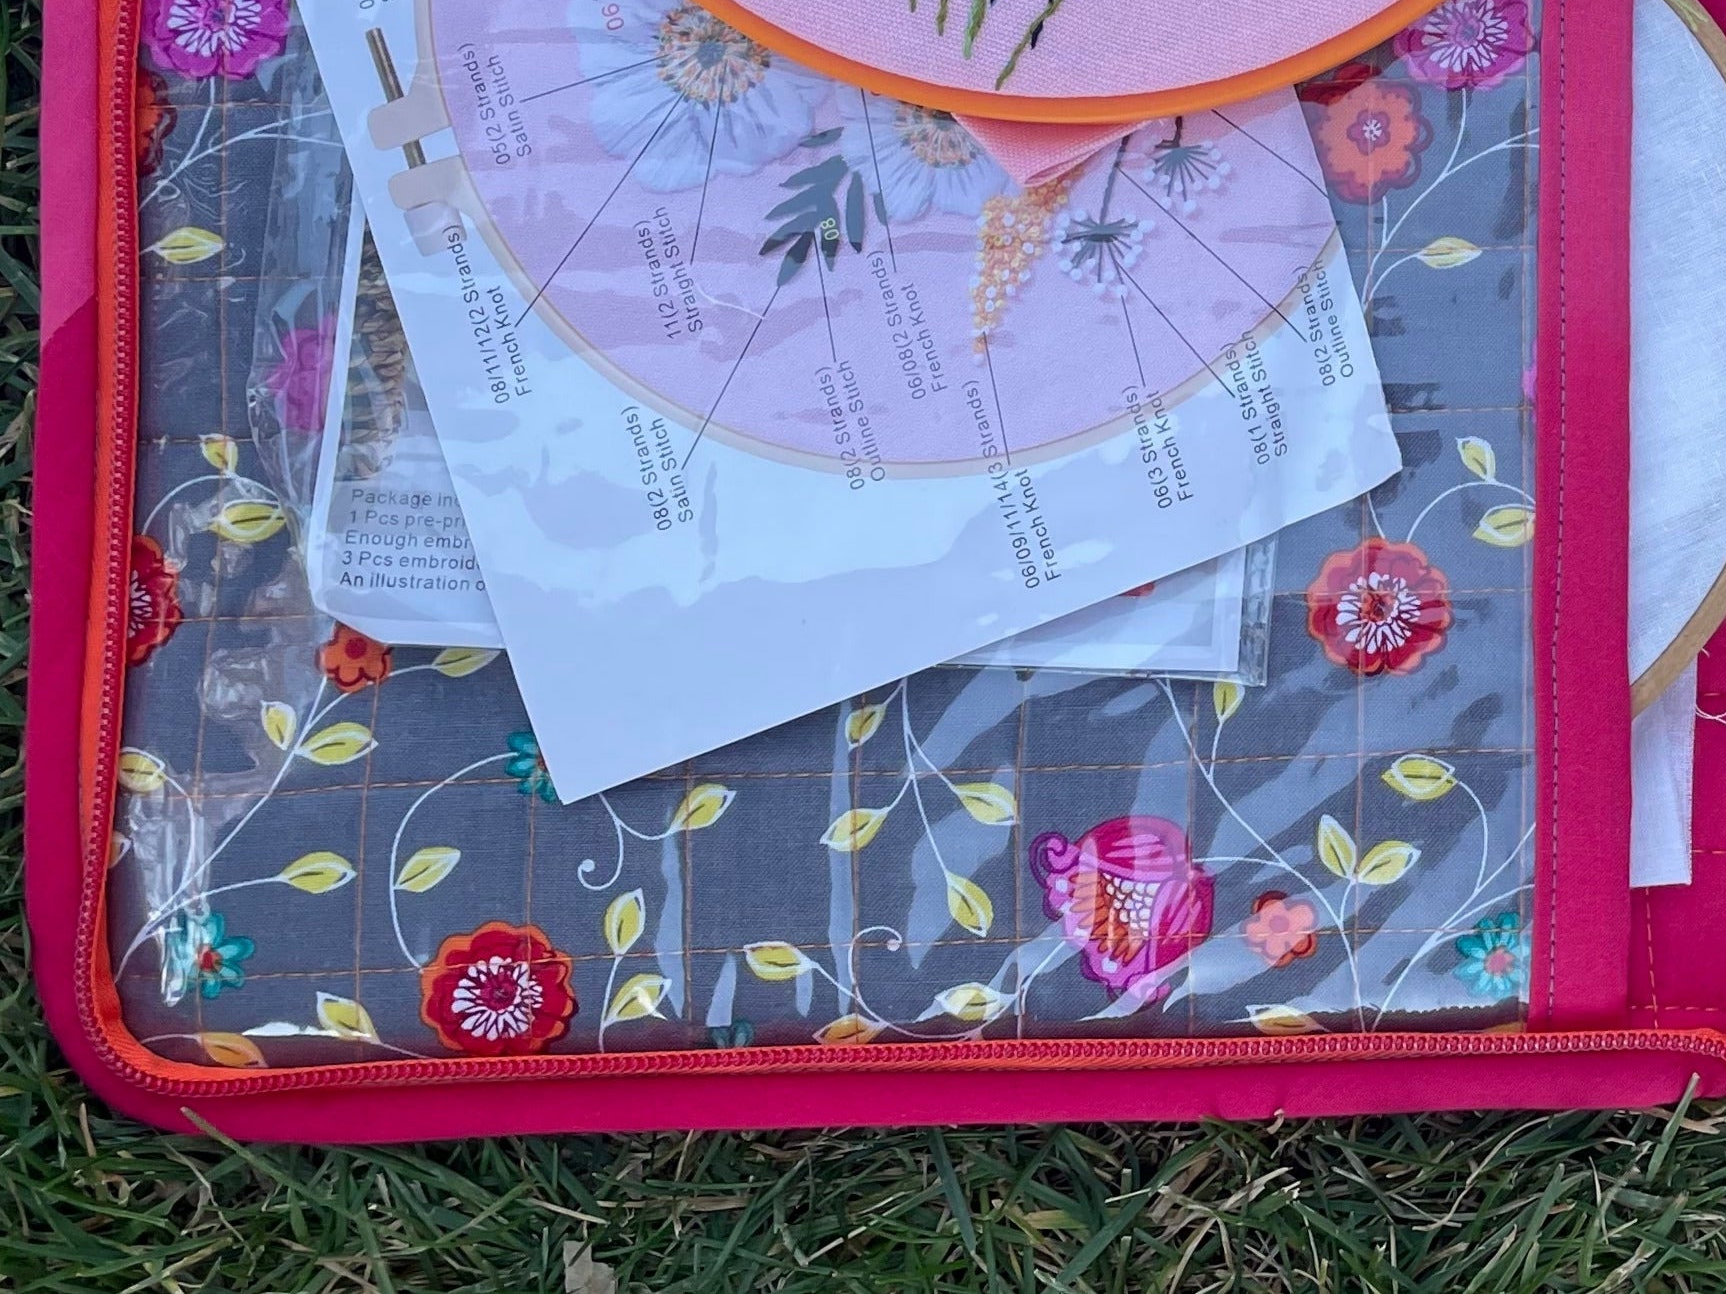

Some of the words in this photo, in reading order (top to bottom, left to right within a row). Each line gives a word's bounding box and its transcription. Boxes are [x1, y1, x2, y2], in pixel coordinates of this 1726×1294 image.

[602, 4, 624, 30] 06
[457, 43, 495, 120] Strands)
[486, 55, 514, 107] Stitch
[508, 110, 531, 157] Satin
[653, 207, 680, 258] Stitch
[820, 218, 839, 240] 08
[443, 225, 479, 303] Strands)
[633, 220, 668, 297] Strands)
[1312, 259, 1334, 311] Stitch
[487, 285, 512, 330] Knot
[670, 261, 703, 332] Straight
[866, 250, 902, 327] Strands)
[902, 283, 926, 327] Knot
[1293, 265, 1323, 342] Strands)
[501, 332, 532, 396] French
[917, 329, 948, 393] French
[1241, 330, 1267, 382] Stitch
[1328, 314, 1354, 378] Outline
[815, 366, 850, 445] Strands)
[837, 360, 864, 413] Stitch
[1220, 343, 1257, 420] Strands)
[962, 380, 998, 459] Strands)
[1122, 386, 1157, 463] Strands)
[1147, 390, 1172, 434] Knot
[1258, 384, 1288, 457] Straight
[621, 406, 657, 486] Strands)
[650, 418, 677, 471] Stitch
[857, 417, 885, 482] Outline
[1162, 436, 1194, 501] French
[352, 489, 432, 509] Package
[670, 474, 694, 523] Satin
[1015, 469, 1040, 513] Knot
[345, 529, 418, 550] Enough
[350, 510, 357, 523] 1
[365, 510, 399, 526] Pcs
[342, 550, 352, 565] 3
[358, 551, 393, 567] Pcs
[1030, 515, 1061, 581] French
[340, 572, 364, 587] An
[370, 573, 470, 591] illustration
